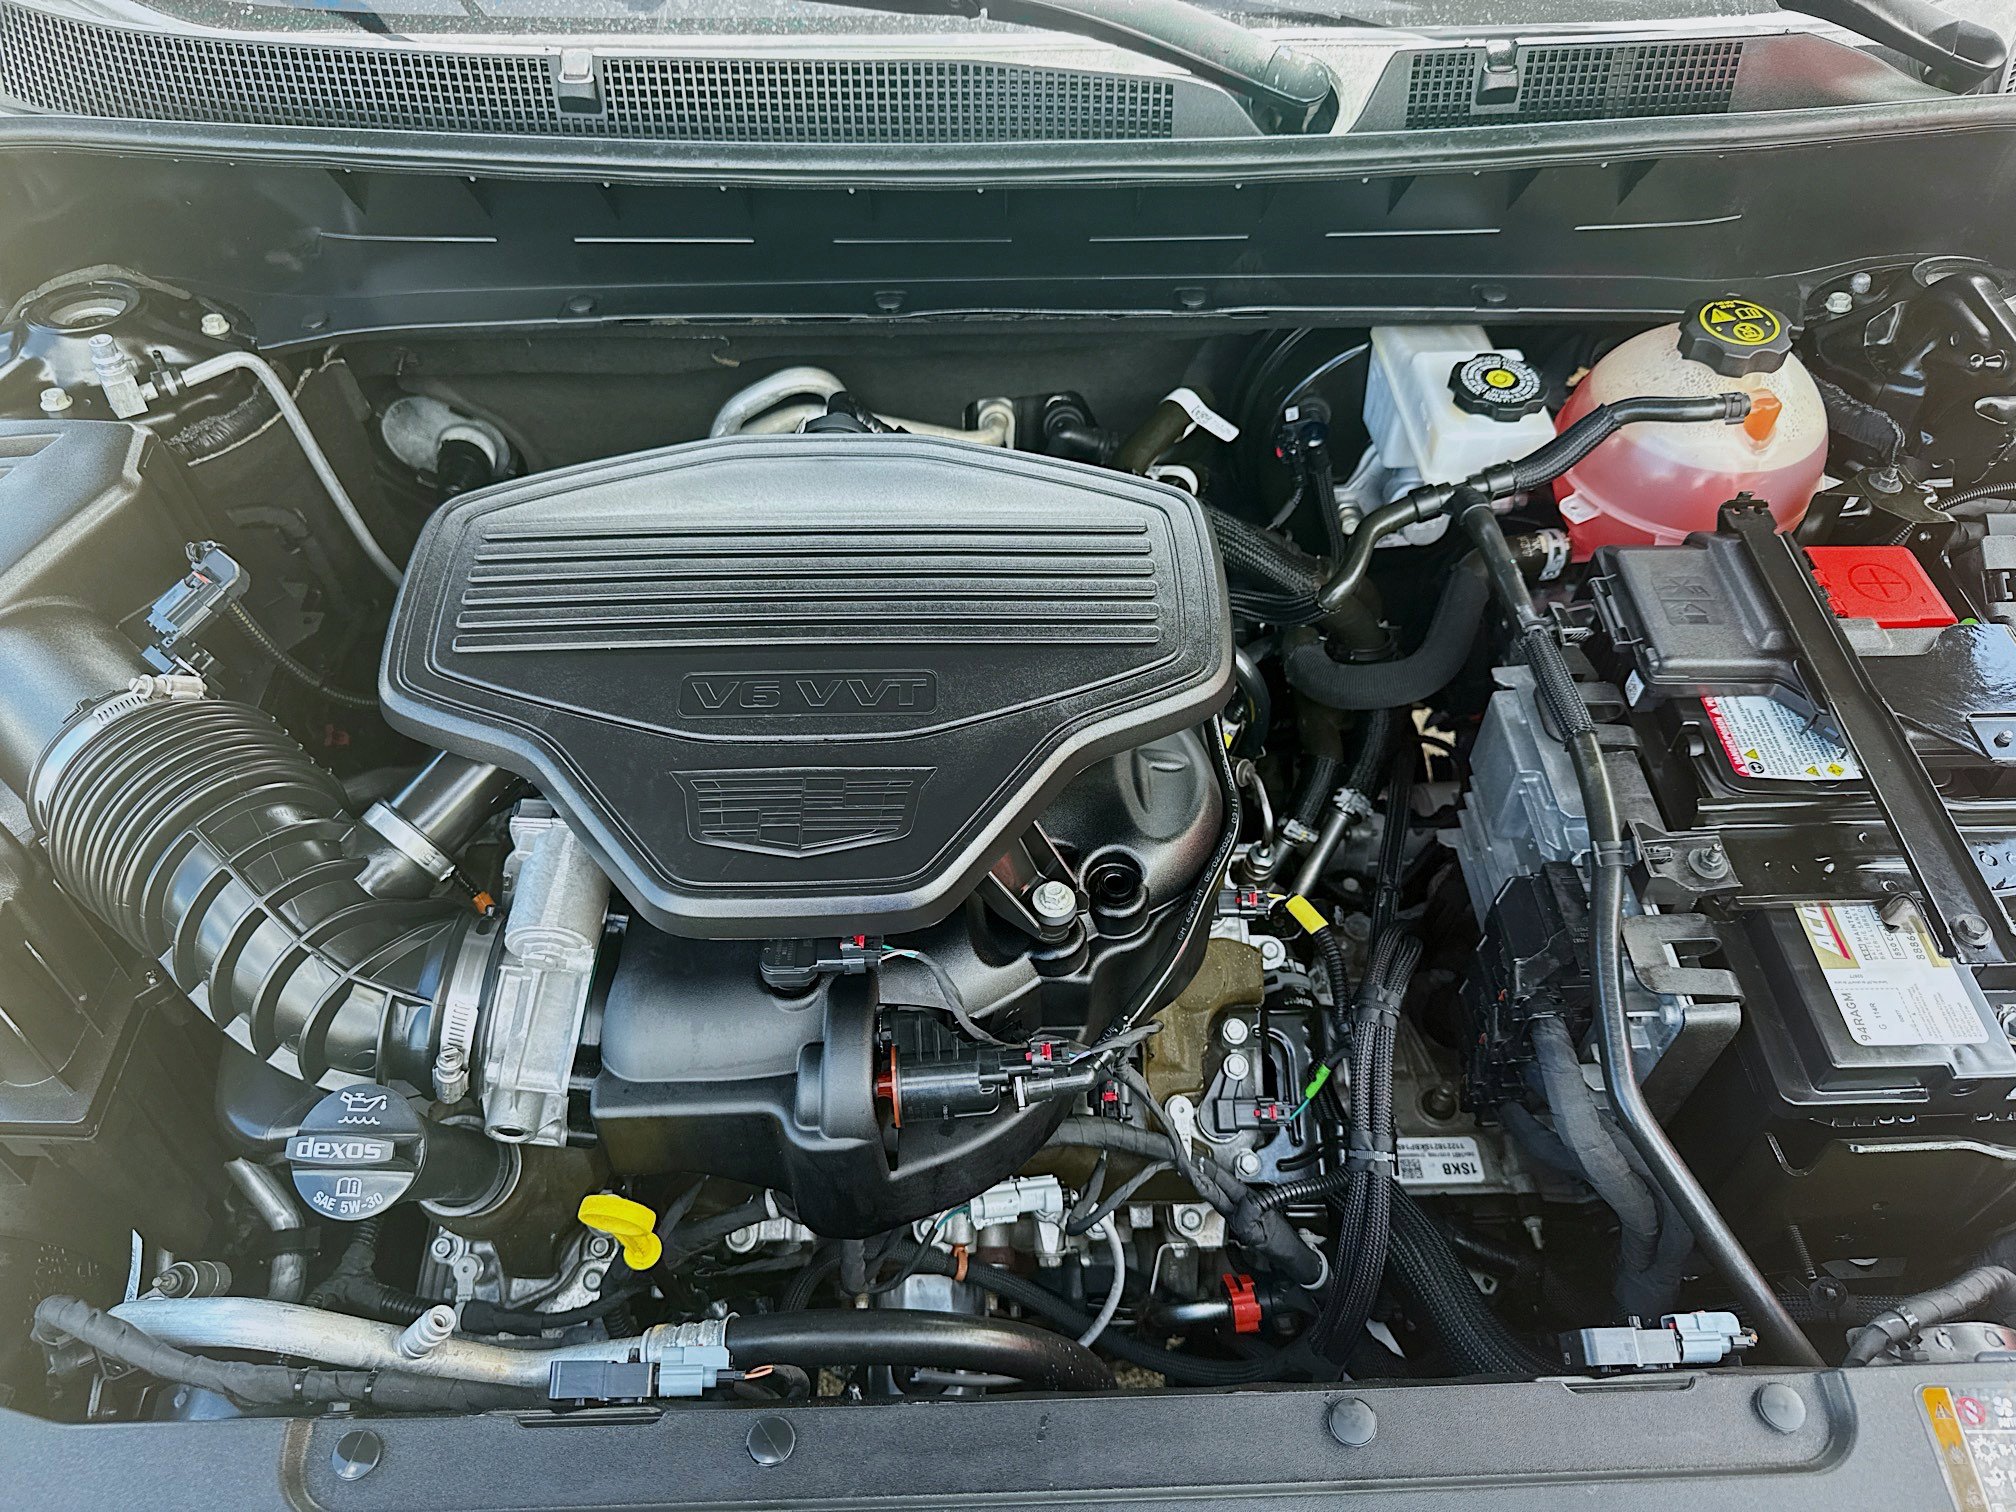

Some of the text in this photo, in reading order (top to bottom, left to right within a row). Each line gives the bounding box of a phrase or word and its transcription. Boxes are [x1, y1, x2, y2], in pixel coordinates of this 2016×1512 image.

[690, 678, 928, 709] V6 VVT
[1177, 927, 1188, 942] GM
[1203, 831, 1234, 884] 05/02/2022
[1890, 943, 1902, 957] 850
[1841, 992, 1872, 1041] 94RAGM
[296, 1137, 382, 1160] dexos
[1442, 1161, 1478, 1175] 1SKB
[312, 1190, 385, 1214] SAE 5W-30
